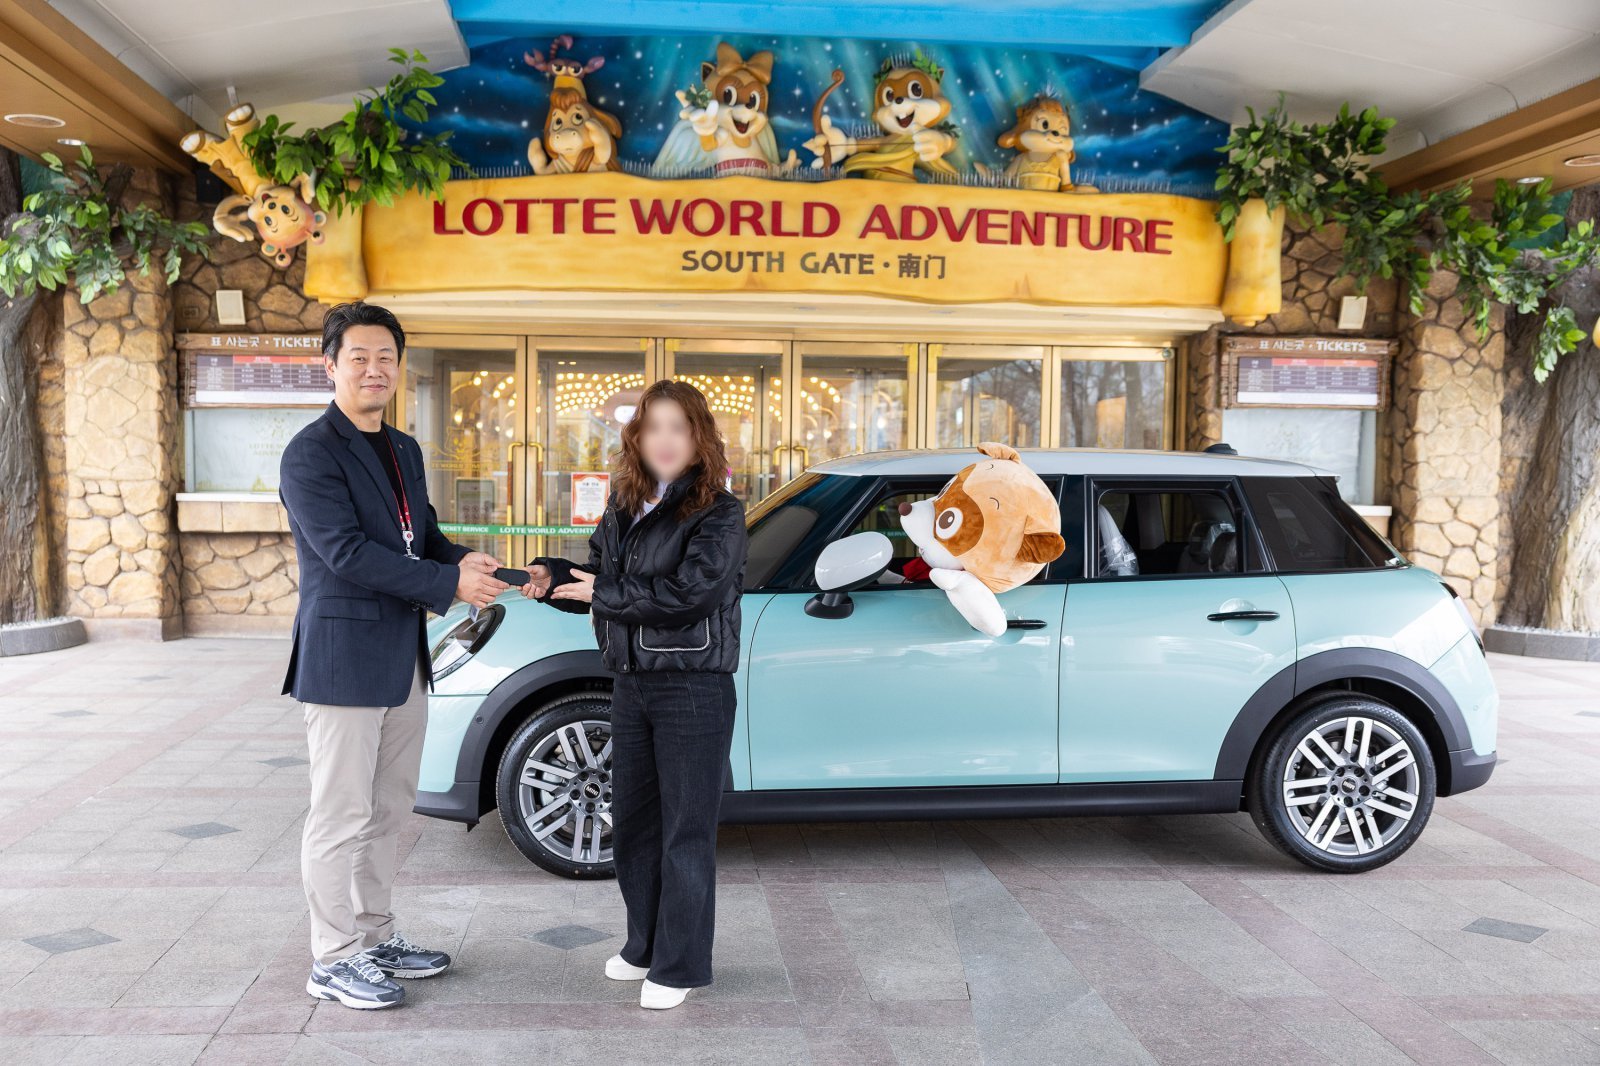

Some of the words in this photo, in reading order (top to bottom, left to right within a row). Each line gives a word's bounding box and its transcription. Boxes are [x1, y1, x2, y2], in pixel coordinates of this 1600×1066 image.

[433, 198, 617, 236] LOTTE
[629, 198, 841, 238] WORLD
[858, 203, 1174, 255] ADVENTURE
[681, 250, 784, 273] SOUTH
[800, 252, 875, 275] GATE
[898, 253, 946, 279] 南门
[1316, 340, 1367, 352] TICKETS
[462, 525, 489, 533] SERVICE
